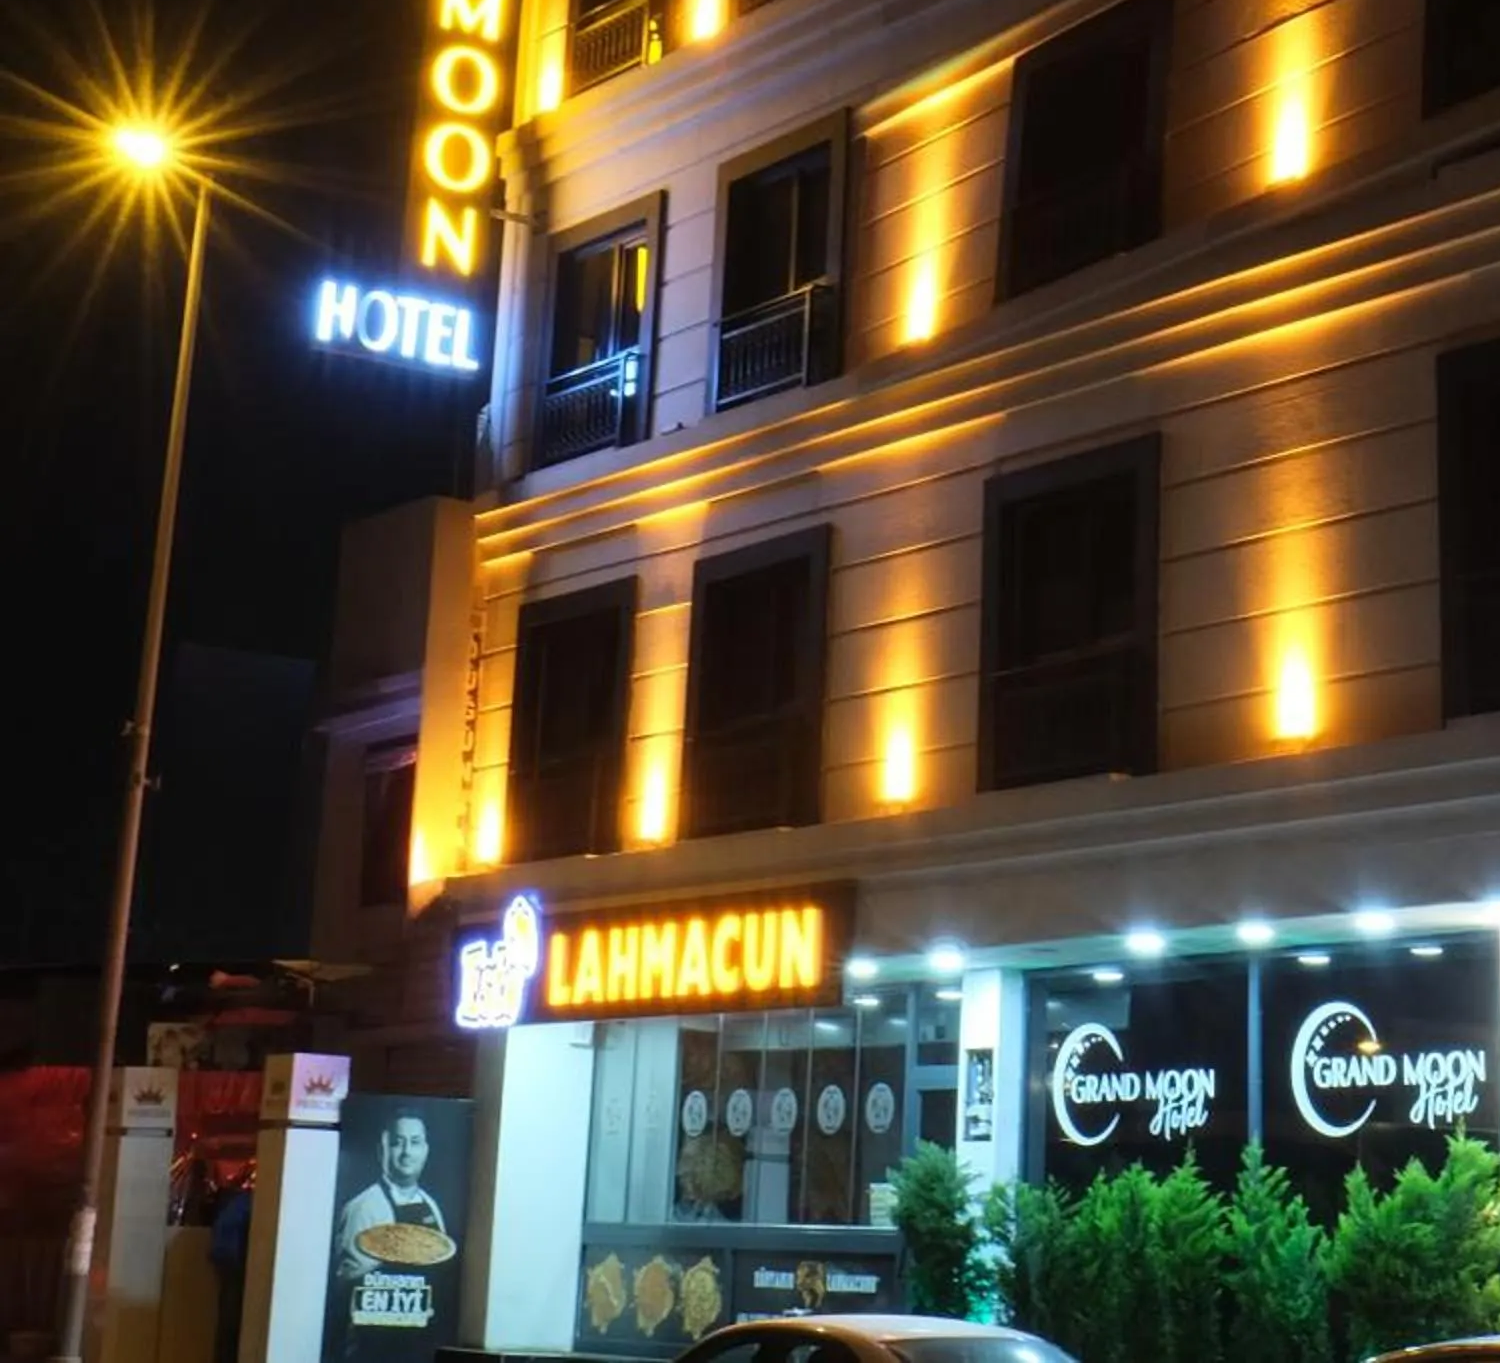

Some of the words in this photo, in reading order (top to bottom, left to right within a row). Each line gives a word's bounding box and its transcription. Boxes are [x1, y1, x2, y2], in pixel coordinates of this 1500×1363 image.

[315, 280, 479, 370] HOTEL
[548, 906, 820, 1006] LAHMACUN
[1070, 1072, 1141, 1104] GRAND
[1145, 1068, 1215, 1100] MOON
[1313, 1055, 1397, 1089] GRAND
[1403, 1050, 1487, 1087] MOON
[1149, 1089, 1209, 1141] Hotel
[1409, 1071, 1479, 1130] Hotel
[361, 1290, 389, 1311] EN
